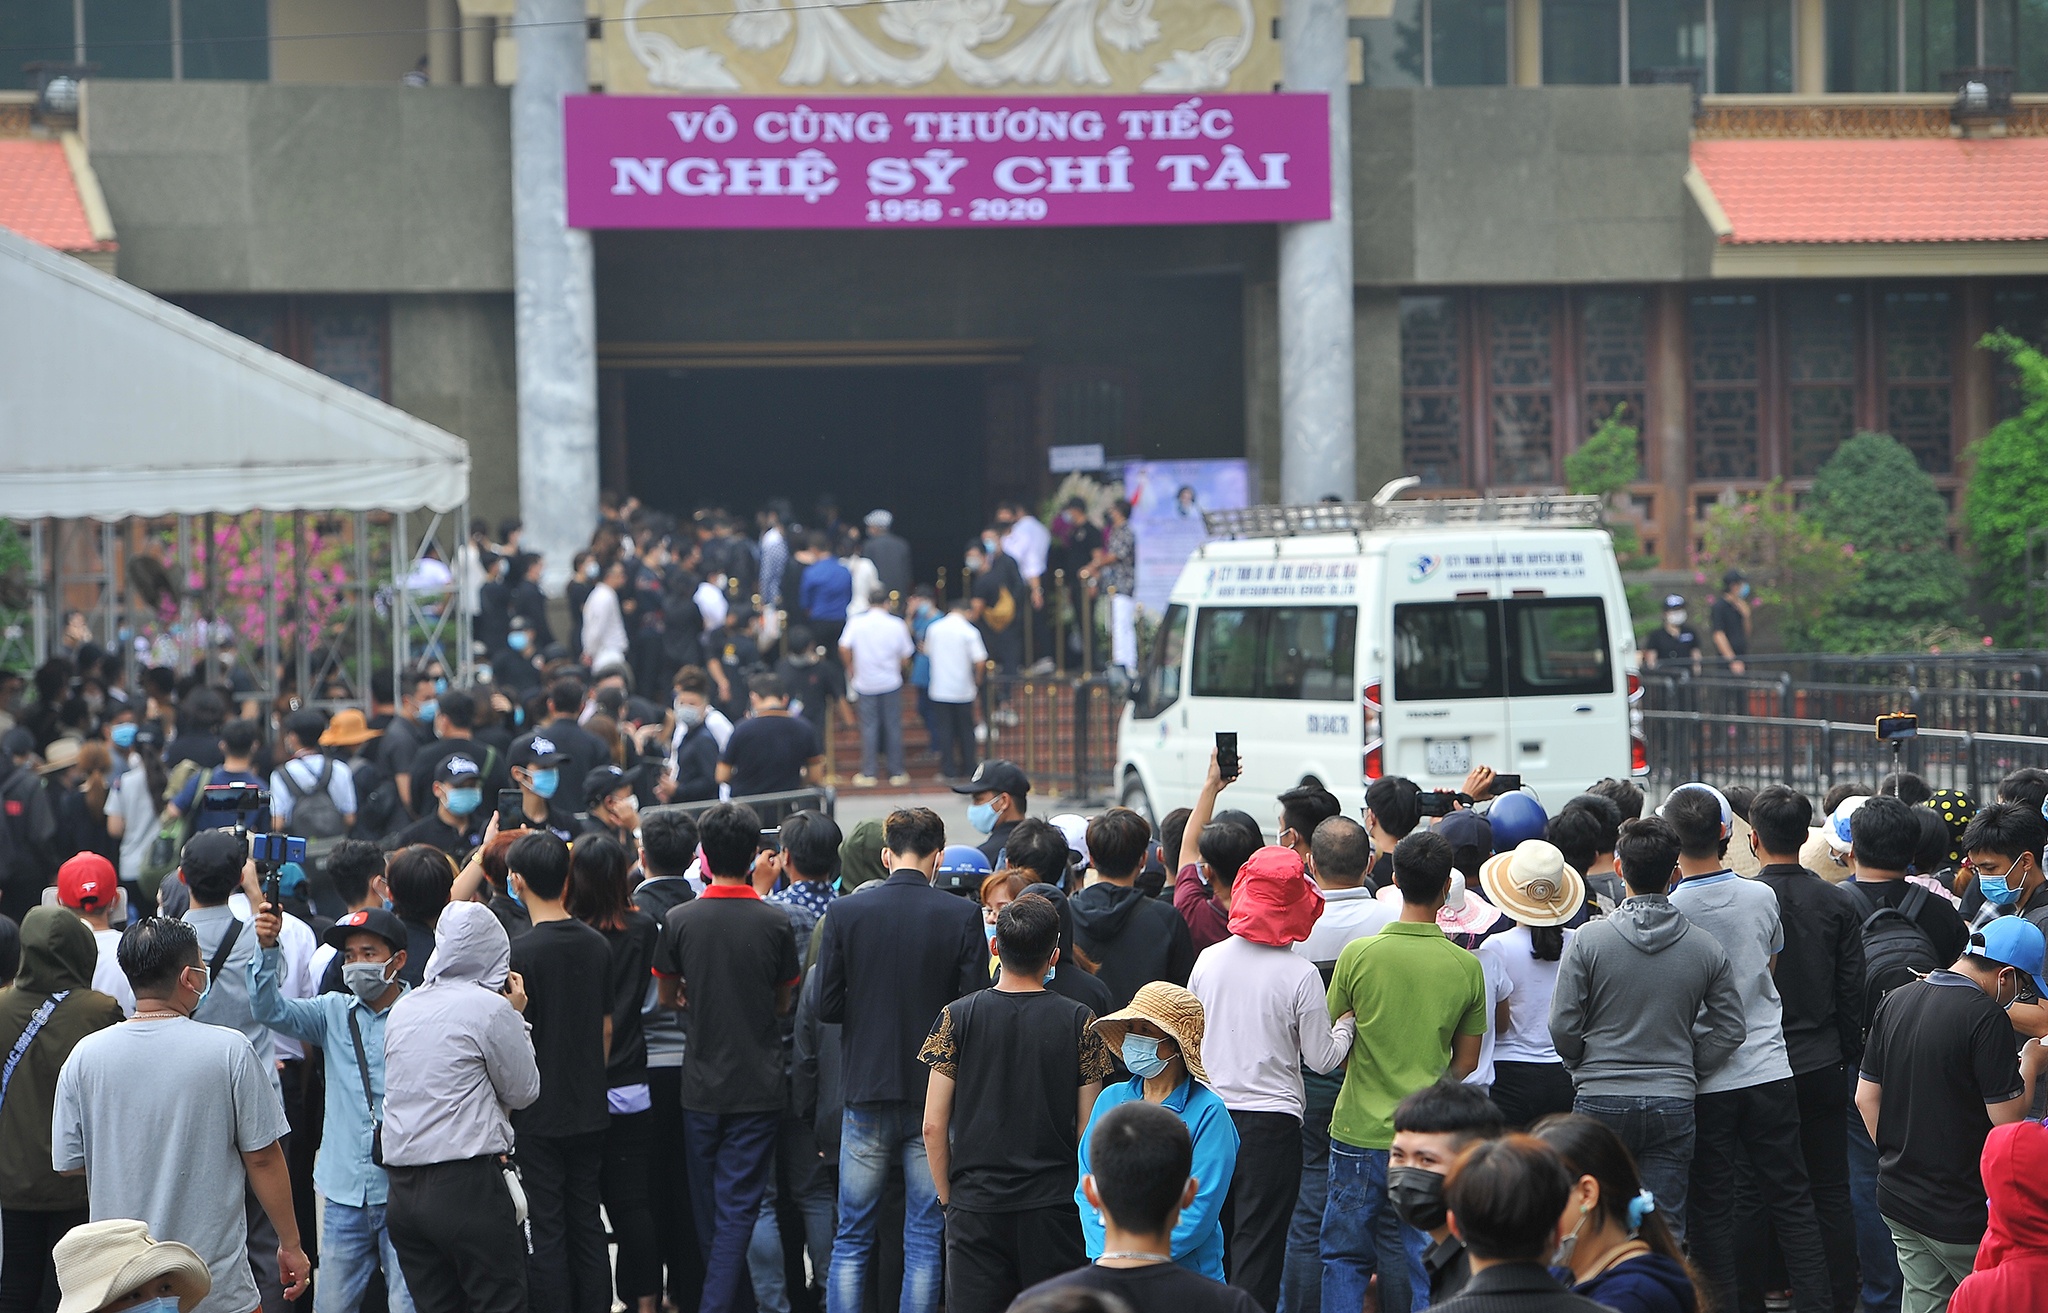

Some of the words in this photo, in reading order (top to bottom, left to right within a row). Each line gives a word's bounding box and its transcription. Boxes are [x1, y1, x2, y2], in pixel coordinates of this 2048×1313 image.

[667, 104, 738, 143] VÔ
[753, 104, 892, 143] CÙNG
[904, 107, 1106, 142] THƯƠNG
[1117, 97, 1234, 140] TIẾC
[609, 148, 839, 204] NGHỆ
[866, 148, 969, 196] SỸ
[993, 145, 1134, 194] CHÍ
[1156, 144, 1290, 191] TÀI
[865, 199, 943, 222] 1958
[969, 198, 1048, 221] 2020
